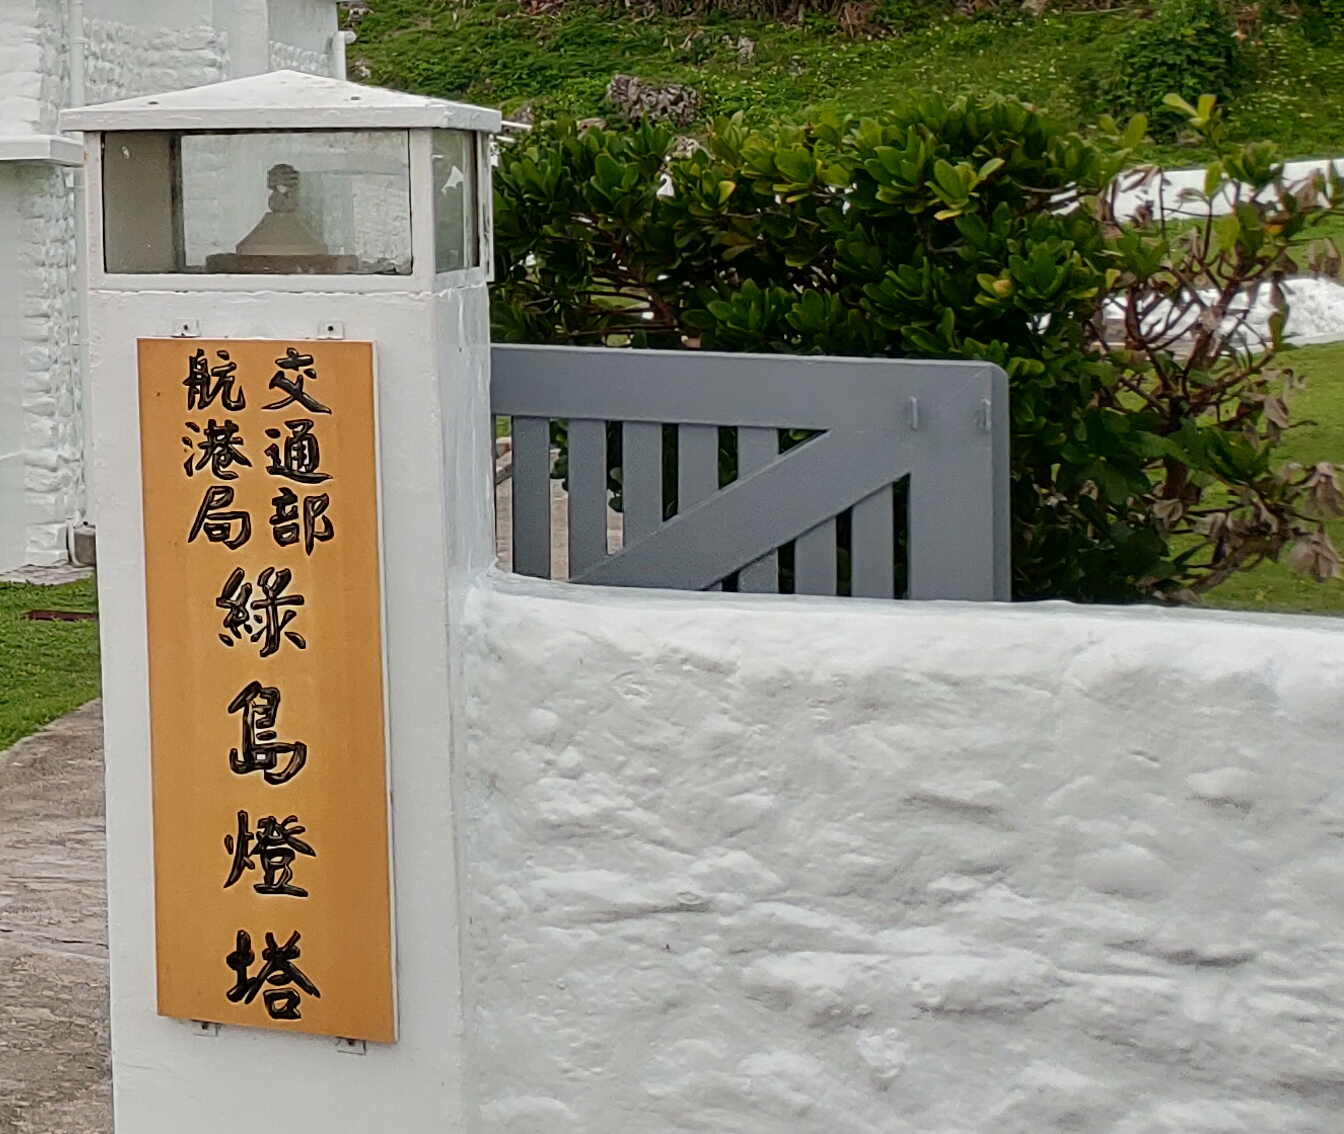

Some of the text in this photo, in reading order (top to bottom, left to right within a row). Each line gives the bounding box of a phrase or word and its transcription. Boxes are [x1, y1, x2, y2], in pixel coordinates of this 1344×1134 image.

[181, 347, 253, 552] 航港局
[260, 346, 335, 556] 交通部
[215, 565, 322, 1022] 綠島燈塔
